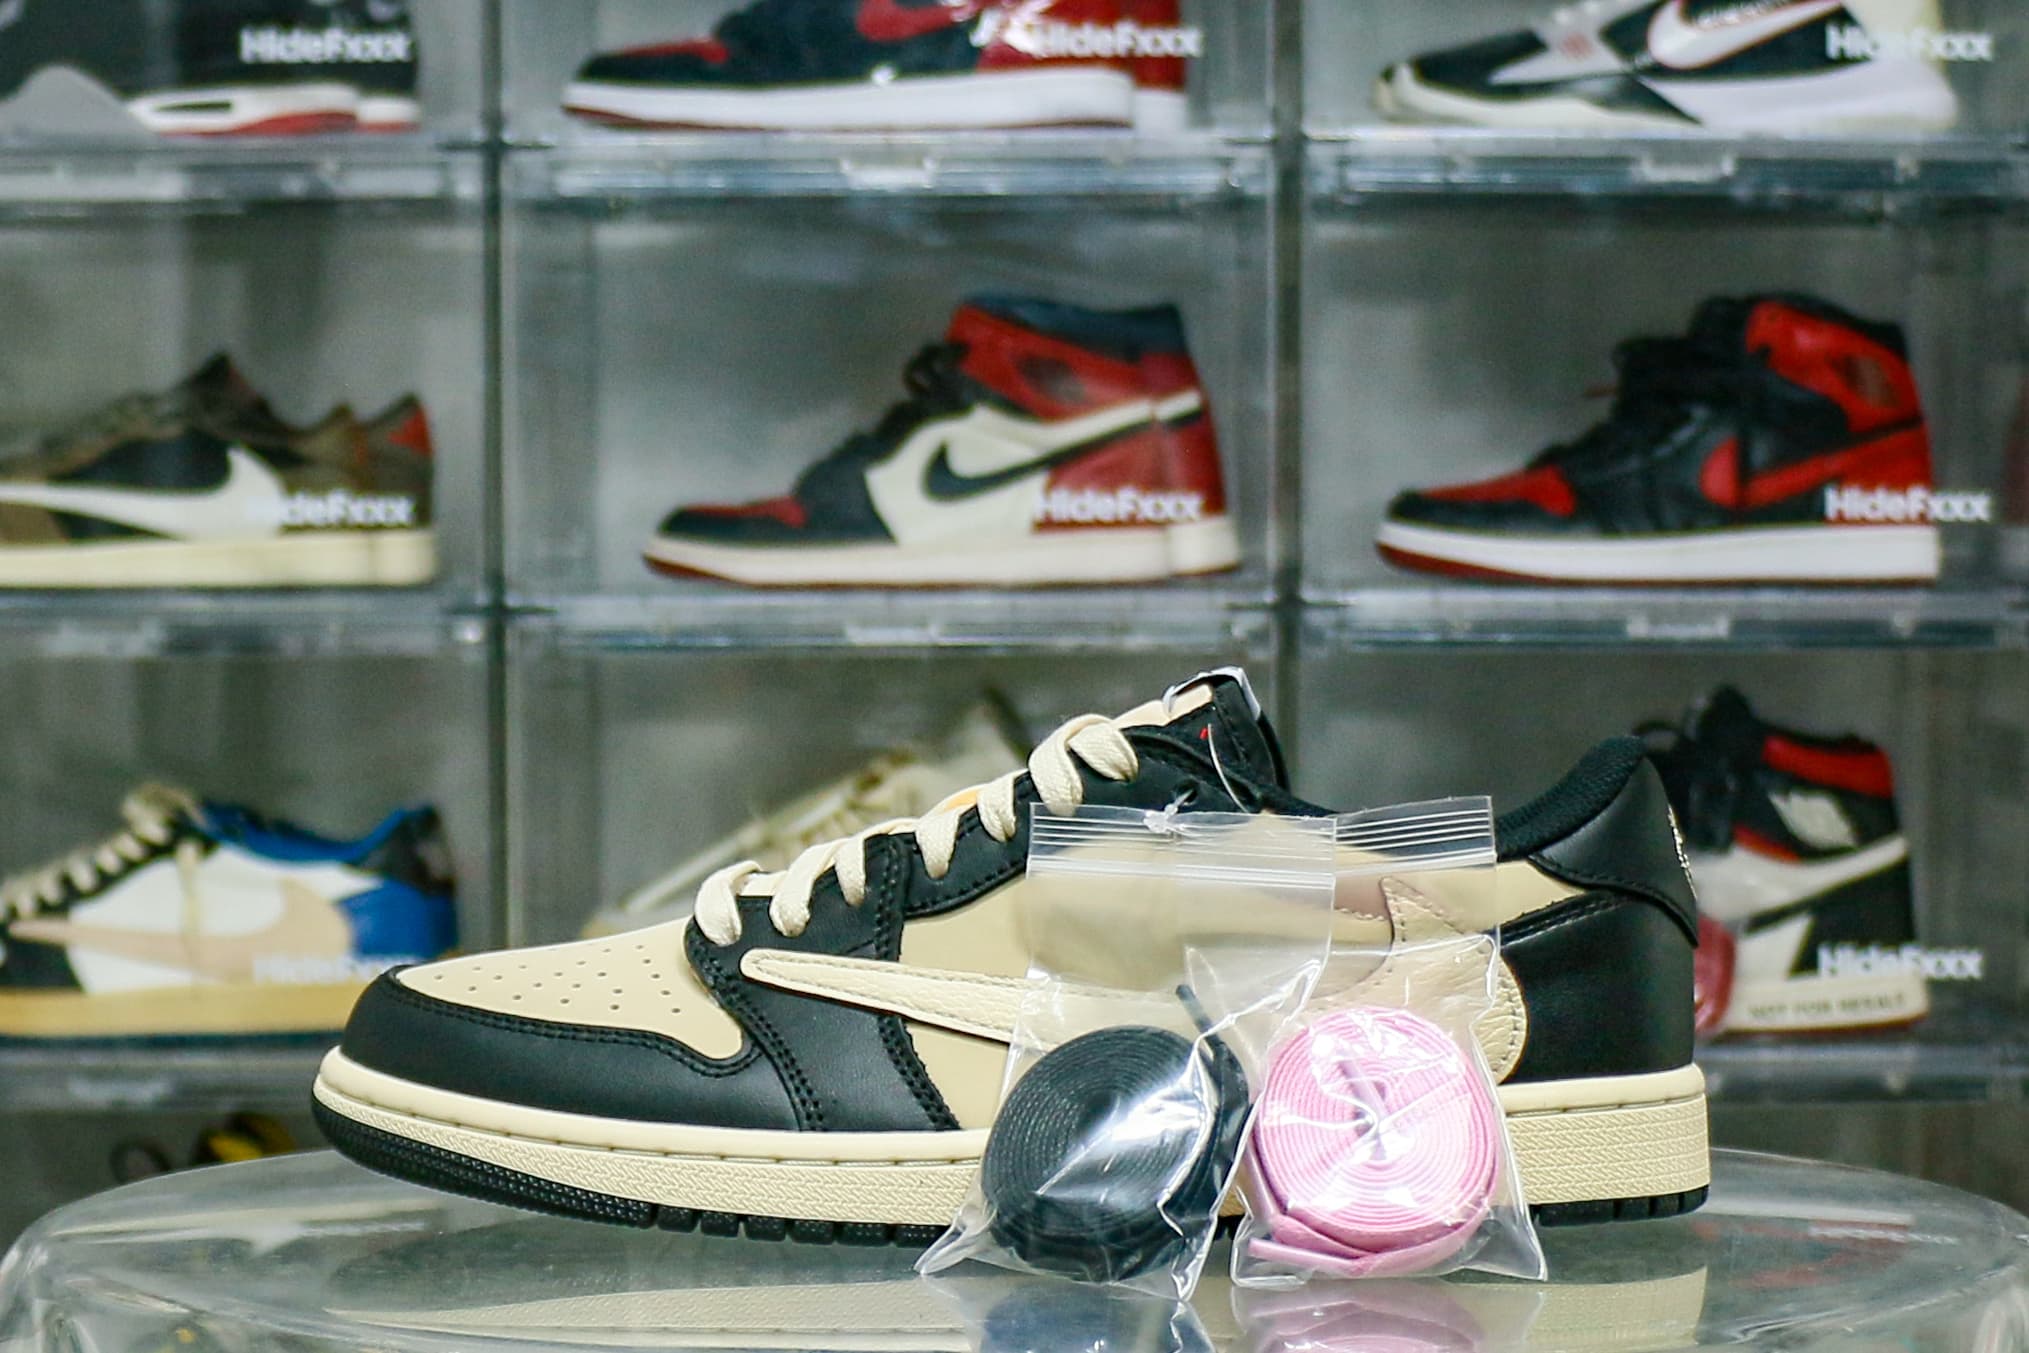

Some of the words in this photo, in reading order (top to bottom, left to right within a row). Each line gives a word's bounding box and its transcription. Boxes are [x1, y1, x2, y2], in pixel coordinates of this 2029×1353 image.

[239, 27, 411, 63] HideFxxx
[246, 491, 414, 525] deFxxx
[1037, 487, 1203, 521] HideFxxx
[1824, 485, 1991, 522] HideFxxx
[1818, 944, 1983, 978] HideFxxx
